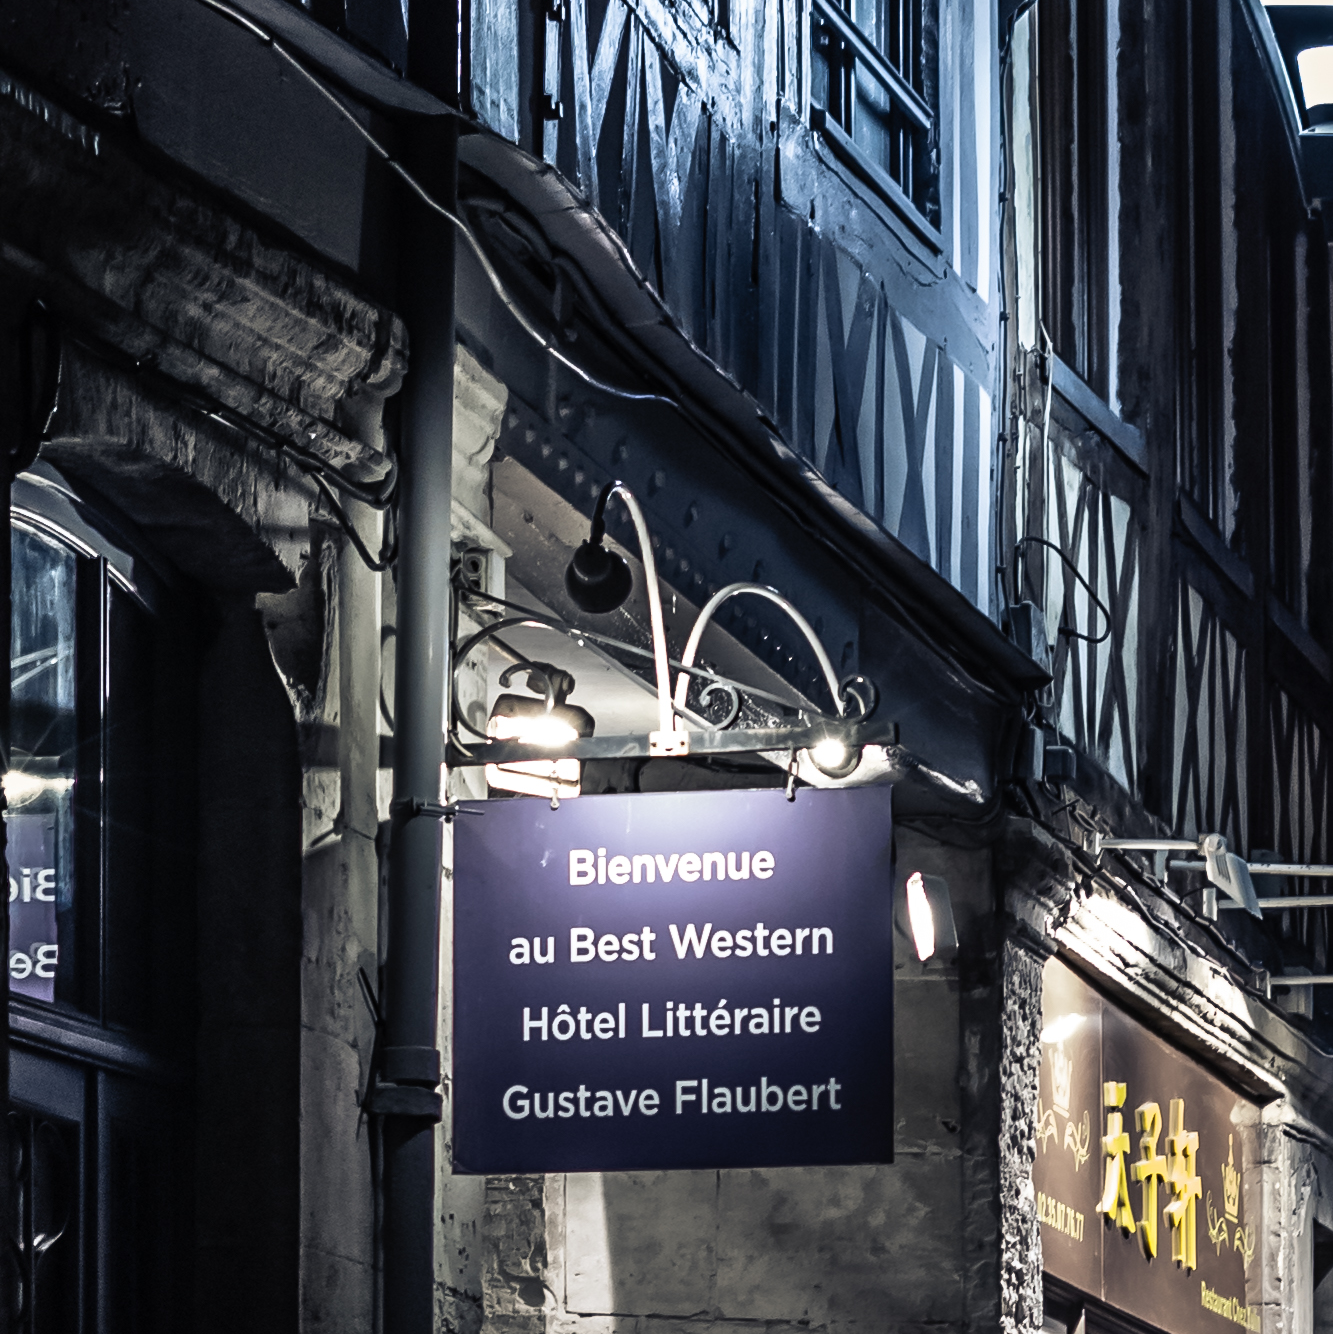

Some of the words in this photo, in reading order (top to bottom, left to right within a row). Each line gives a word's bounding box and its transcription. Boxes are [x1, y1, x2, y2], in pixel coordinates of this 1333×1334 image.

[568, 847, 776, 886] Bienvenue
[508, 935, 556, 965] au
[569, 925, 657, 963] Best
[668, 921, 834, 960] Western
[522, 1003, 627, 1042] Hôtel
[641, 997, 822, 1039] Littéraire
[502, 1083, 660, 1120] Gustave
[675, 1076, 842, 1115] Flaubert
